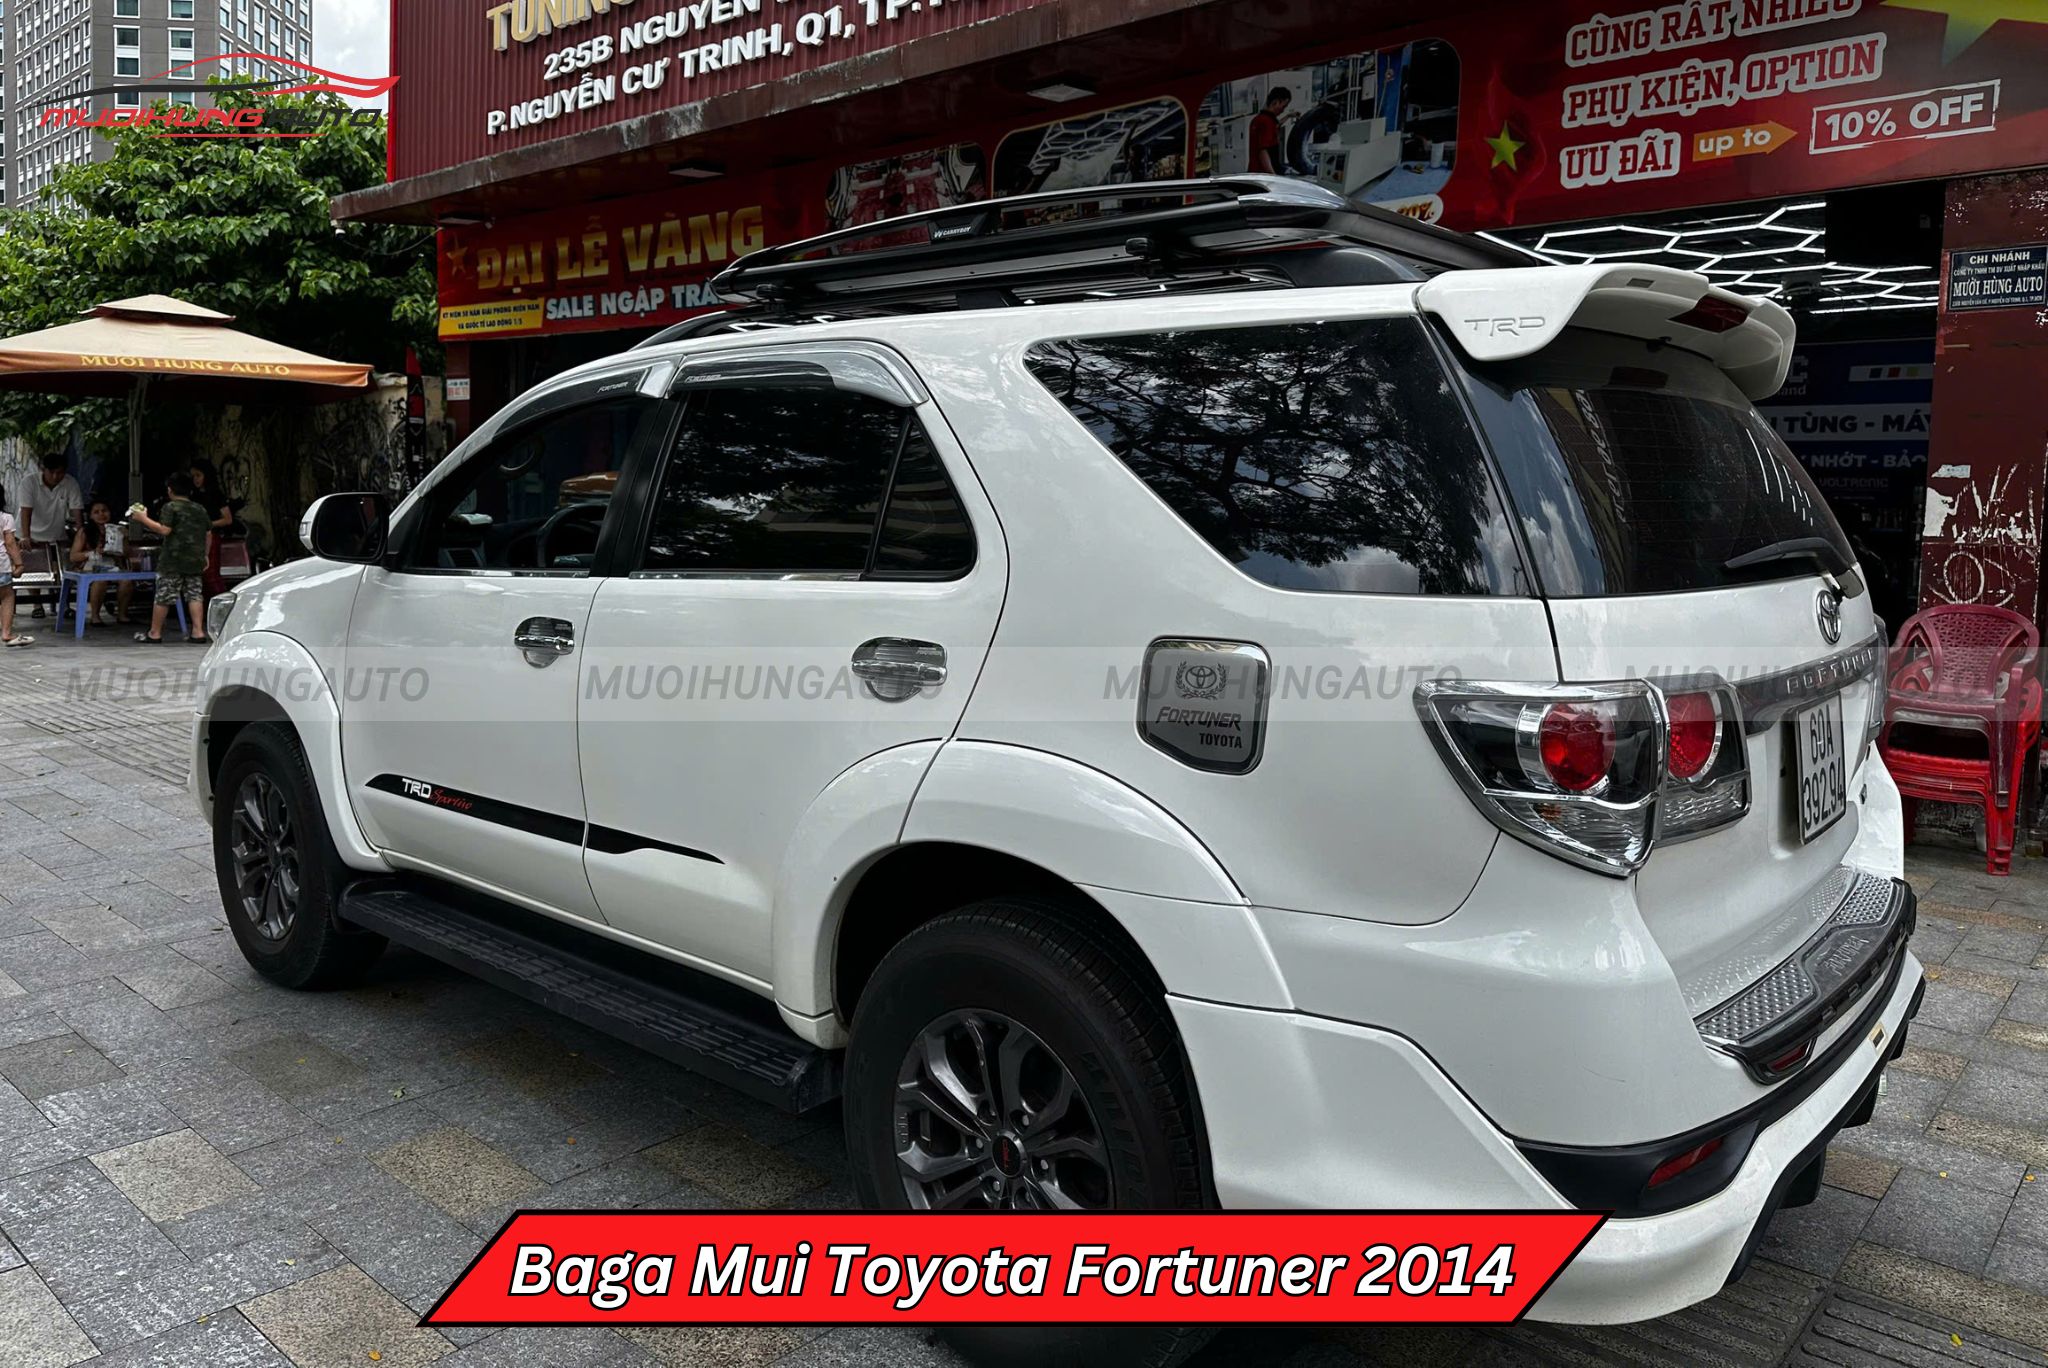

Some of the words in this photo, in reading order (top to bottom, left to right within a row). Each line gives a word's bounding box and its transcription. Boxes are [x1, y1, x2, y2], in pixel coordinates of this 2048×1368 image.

[1570, 16, 1651, 61] CÙNG
[543, 35, 613, 80] 235B
[622, 57, 671, 95] CƯ
[1568, 83, 1632, 121] PHỤ
[1640, 66, 1735, 110] KIỆN,
[1745, 39, 1879, 93] OPTION
[1825, 107, 1897, 142] 10%
[1909, 91, 1985, 129] OFF
[1699, 136, 1734, 156] up
[1742, 128, 1772, 147] to
[1565, 148, 1611, 180] ƯU
[1618, 136, 1676, 176] ĐÃI
[477, 241, 545, 294] ĐẠI
[556, 216, 609, 281] LỄ
[622, 206, 765, 273] VÀNG
[1969, 254, 1989, 264] CHI
[1991, 250, 2031, 263] NHÁNH
[1953, 277, 1980, 297] MƯỜI
[1982, 275, 2013, 295] HÙNG
[2014, 275, 2043, 293] AUTO
[546, 295, 595, 320] SALE
[601, 285, 665, 318] NGẬP
[1464, 316, 1546, 337] TRD
[152, 358, 223, 371] HUNG
[230, 361, 291, 375] AUTO
[1783, 411, 1858, 434] TÙNG
[1811, 452, 1868, 468] NHỚT
[1155, 706, 1242, 732] FORTUNER
[1199, 732, 1242, 749] TOYOTA
[1810, 704, 1834, 765] 60A
[402, 778, 432, 799] TRD
